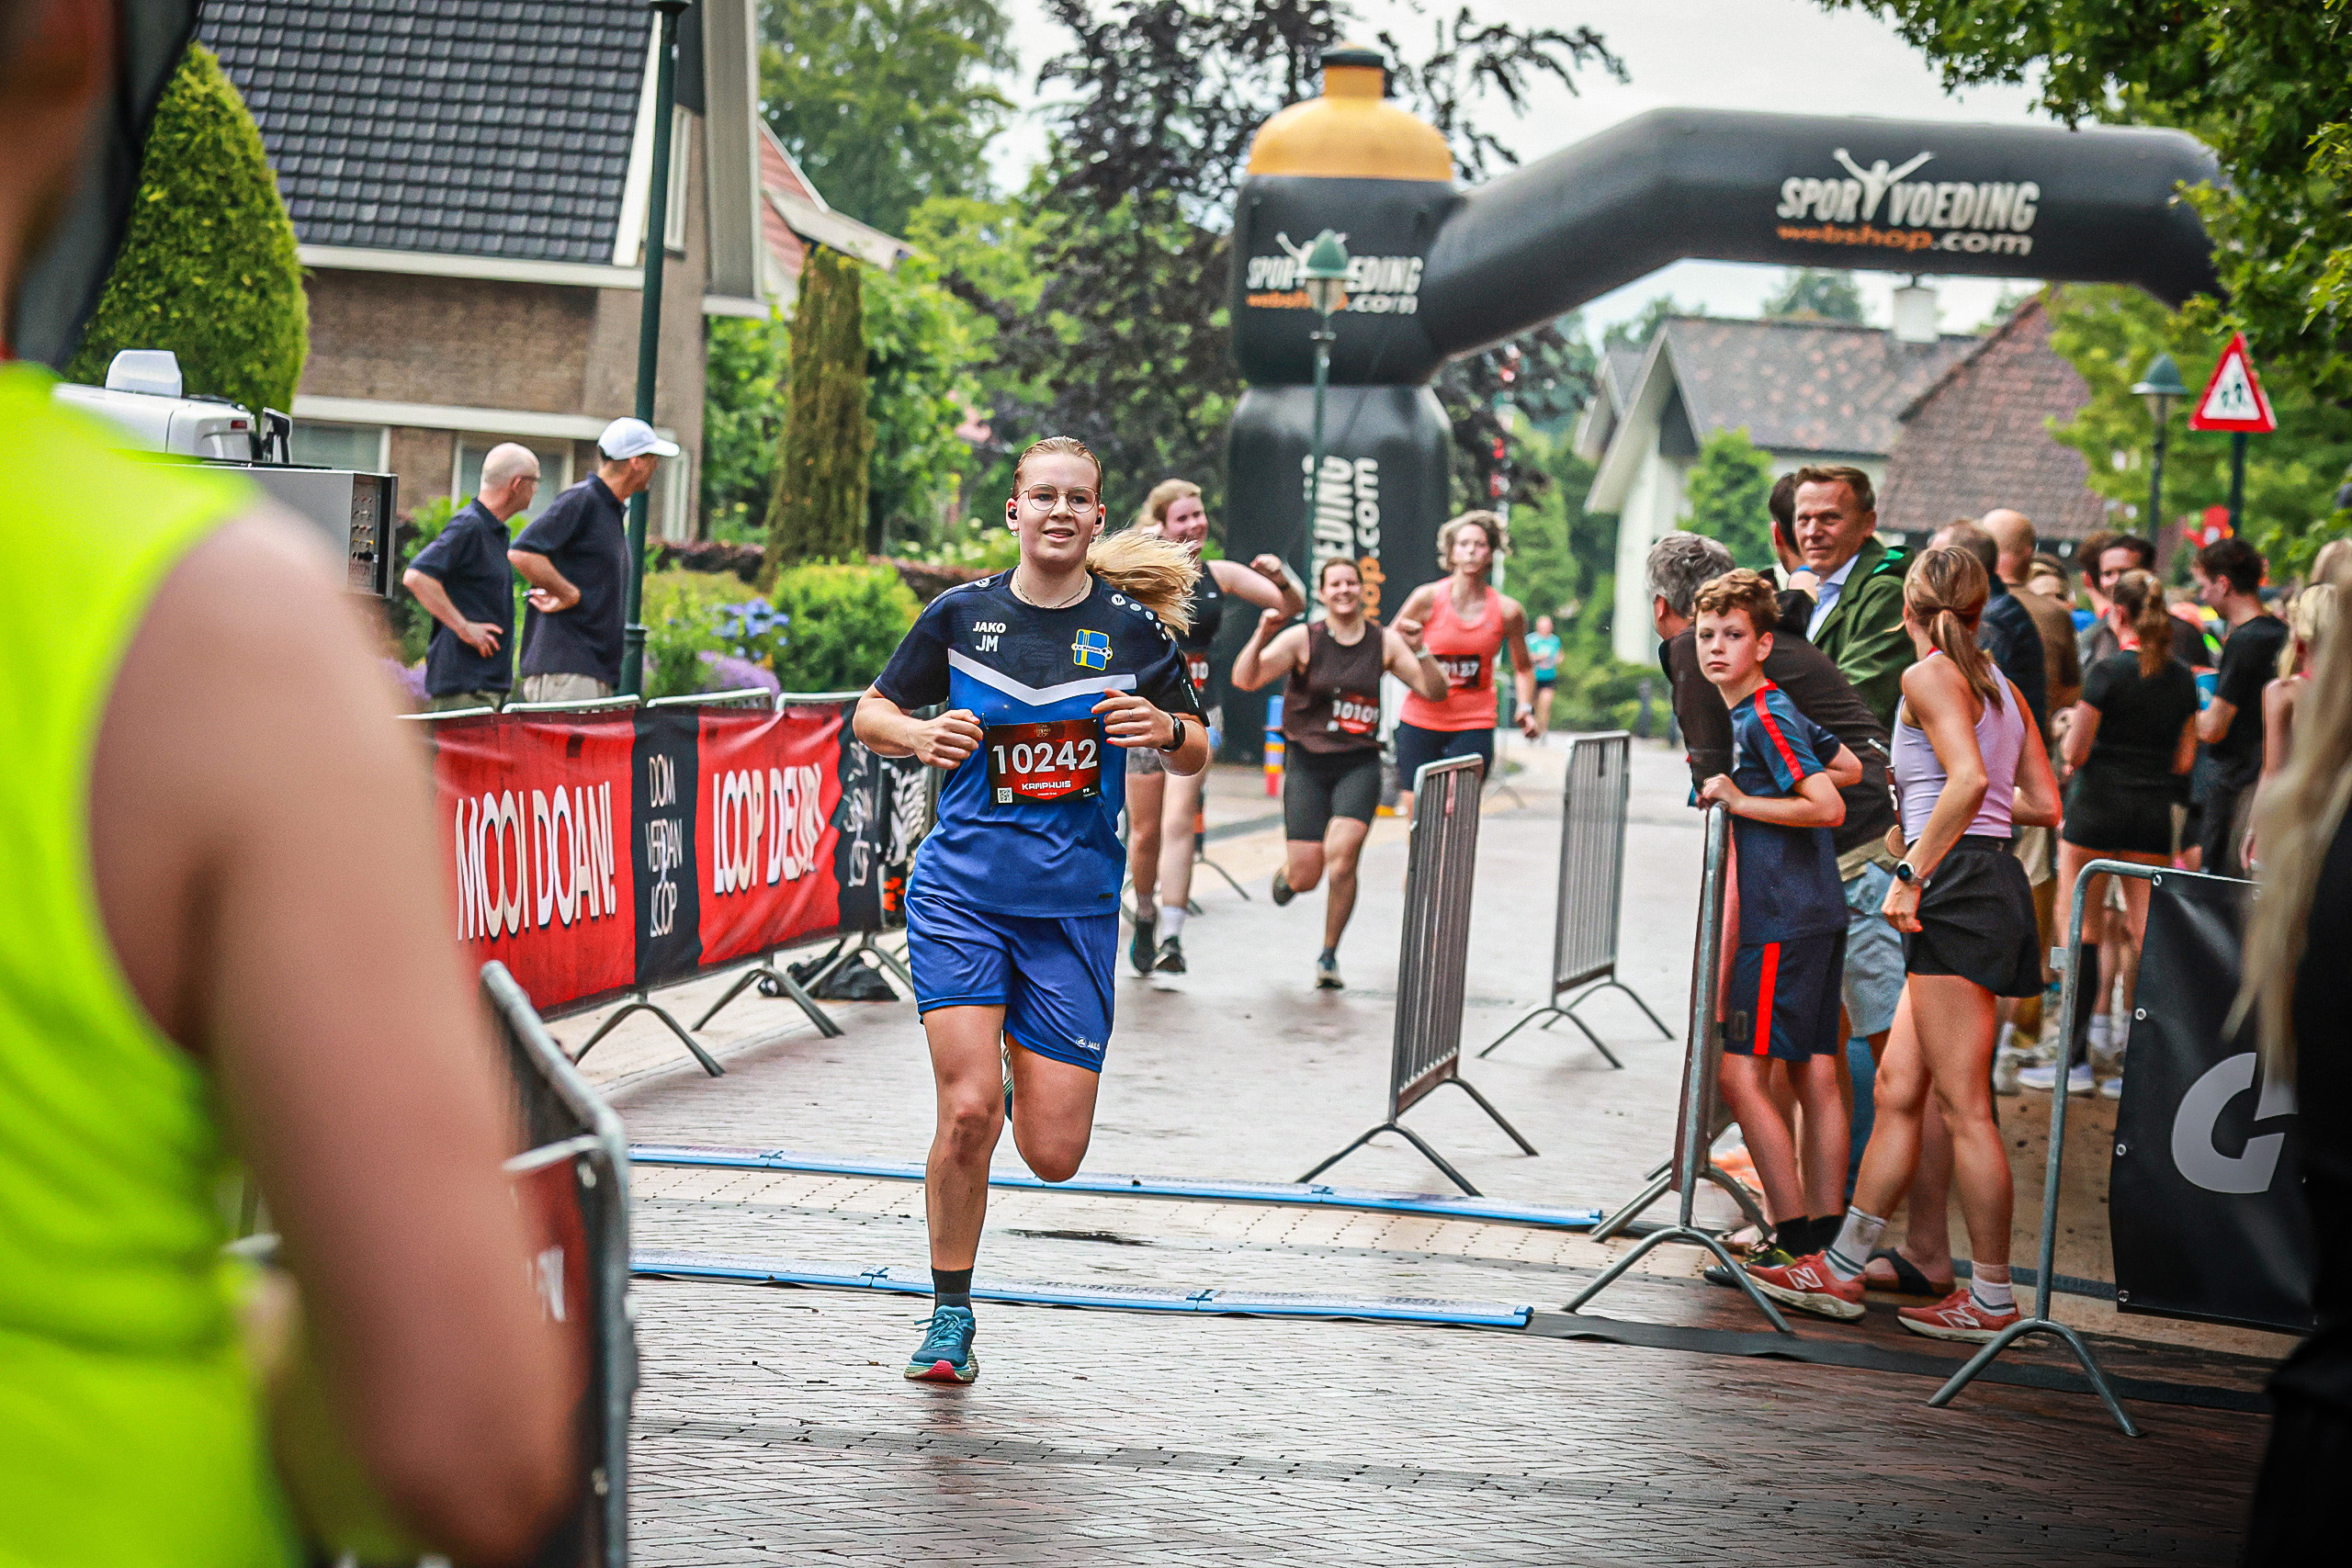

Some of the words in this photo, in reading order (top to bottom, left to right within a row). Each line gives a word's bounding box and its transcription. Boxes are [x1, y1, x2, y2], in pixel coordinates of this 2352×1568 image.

[972, 621, 1007, 634] JAKO
[975, 634, 1000, 652] JM
[992, 739, 1098, 774] 10242
[649, 753, 676, 808] DOM
[1022, 780, 1071, 791] KAMPHUIS
[713, 769, 765, 894] LOOP
[455, 789, 530, 942] MOOI
[532, 781, 616, 927] DOAN!
[650, 880, 678, 938] LOOP
